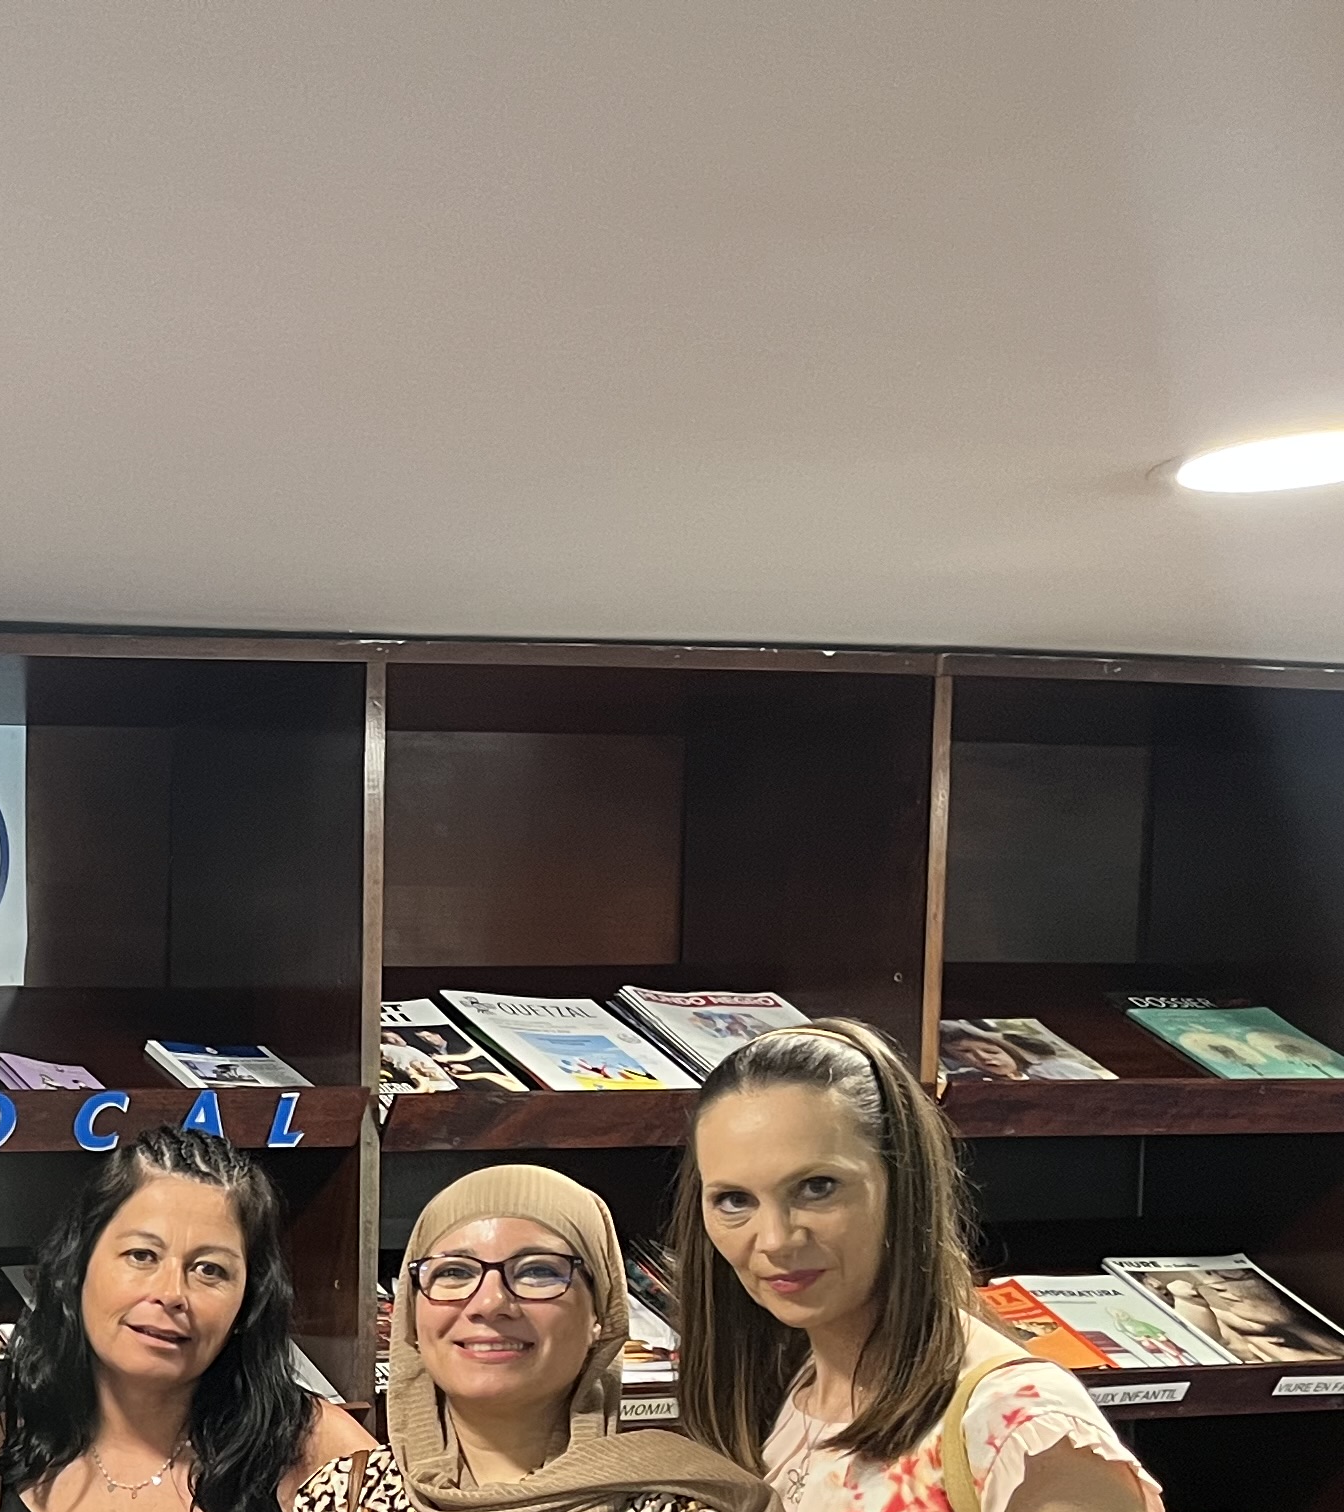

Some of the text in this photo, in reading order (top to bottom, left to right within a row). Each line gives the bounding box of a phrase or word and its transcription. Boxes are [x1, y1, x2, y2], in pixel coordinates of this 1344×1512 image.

[496, 1001, 598, 1019] QUETZAL
[1112, 1259, 1162, 1269] VIURE
[1278, 1381, 1312, 1393] VIURE
[1313, 1380, 1327, 1392] EN
[1119, 1387, 1179, 1403] INFANTIL
